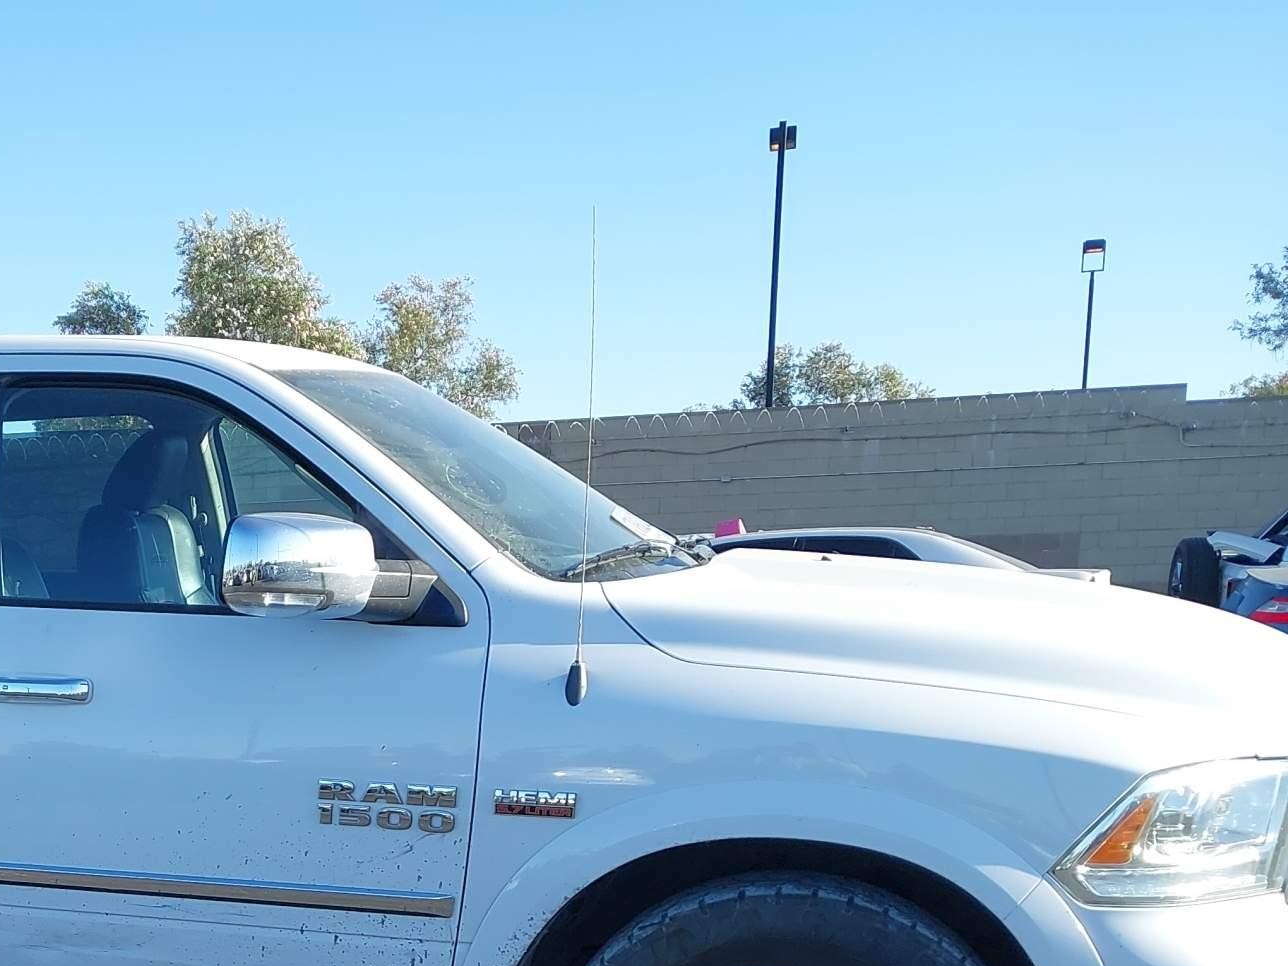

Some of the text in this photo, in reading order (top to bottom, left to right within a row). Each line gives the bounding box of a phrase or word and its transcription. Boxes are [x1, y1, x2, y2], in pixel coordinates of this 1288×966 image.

[318, 778, 458, 809] RAM
[494, 788, 577, 805] HEMI
[317, 803, 456, 834] 1500
